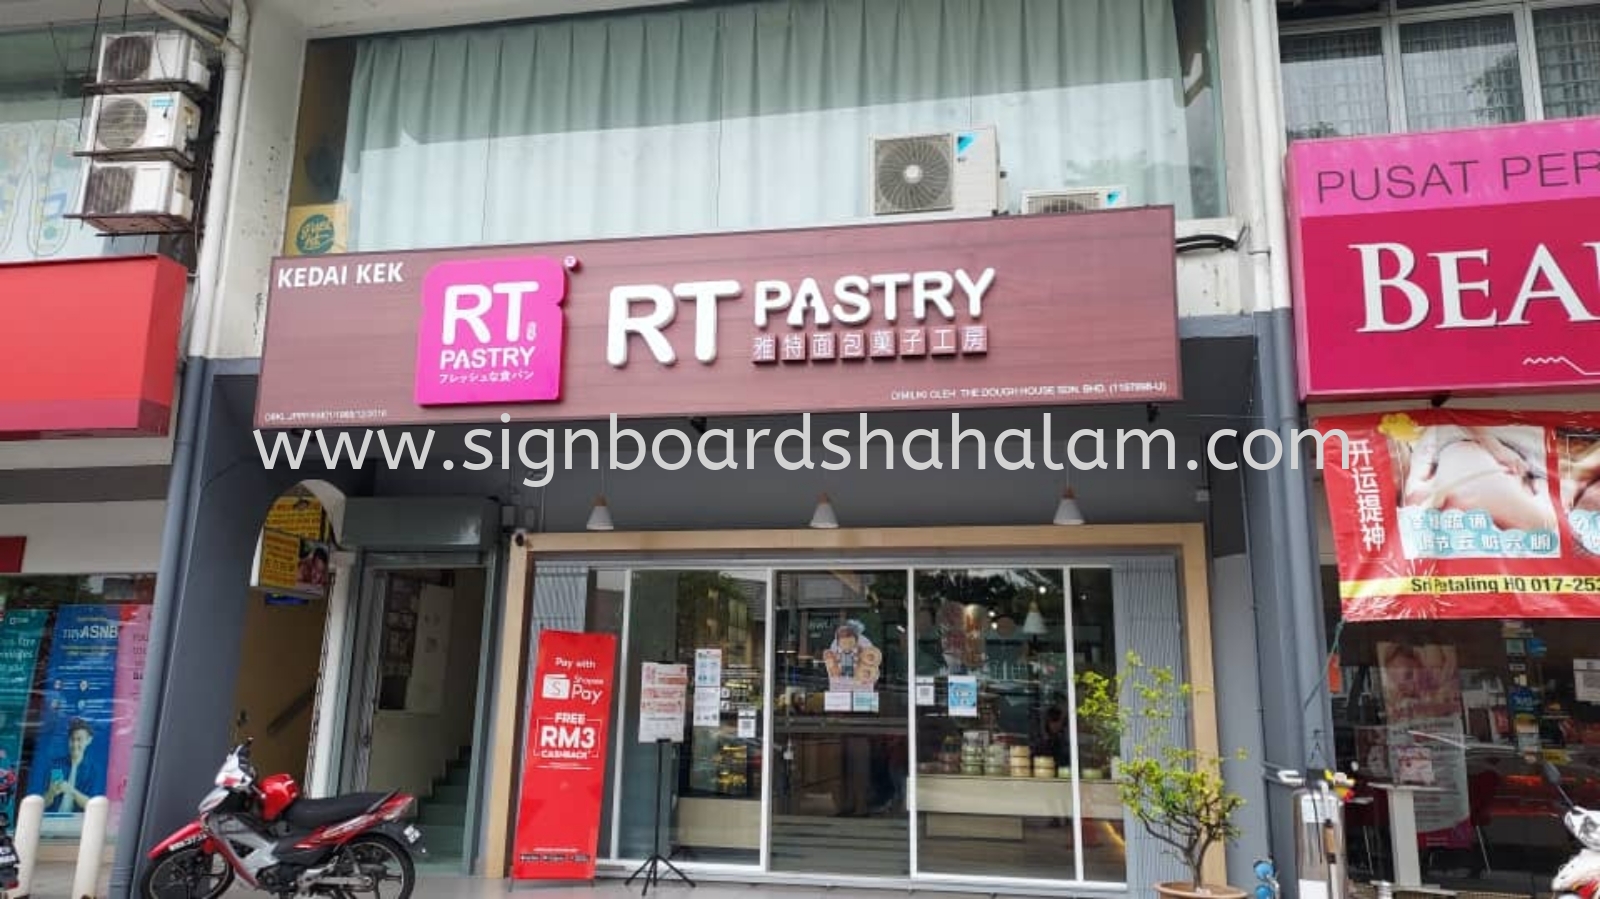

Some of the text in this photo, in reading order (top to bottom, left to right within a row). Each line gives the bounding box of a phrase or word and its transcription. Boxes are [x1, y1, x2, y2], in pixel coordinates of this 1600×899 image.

[1316, 159, 1479, 203] PUSAT
[278, 262, 404, 289] KEDAI KEK
[753, 267, 996, 328] PASTRY
[442, 281, 539, 346] RT
[606, 280, 741, 367] RT
[440, 346, 536, 370] PASTRY
[1020, 385, 1055, 396] HOUSE
[1347, 438, 1386, 552] 开运提神
[1411, 577, 1432, 593] Sri
[1434, 577, 1499, 595] Petaling
[1504, 577, 1527, 593] HQ
[555, 657, 597, 671] Pay with
[572, 674, 604, 686] Shopee
[571, 683, 604, 706] Pay
[554, 711, 587, 725] FREE
[540, 725, 596, 750] RM3
